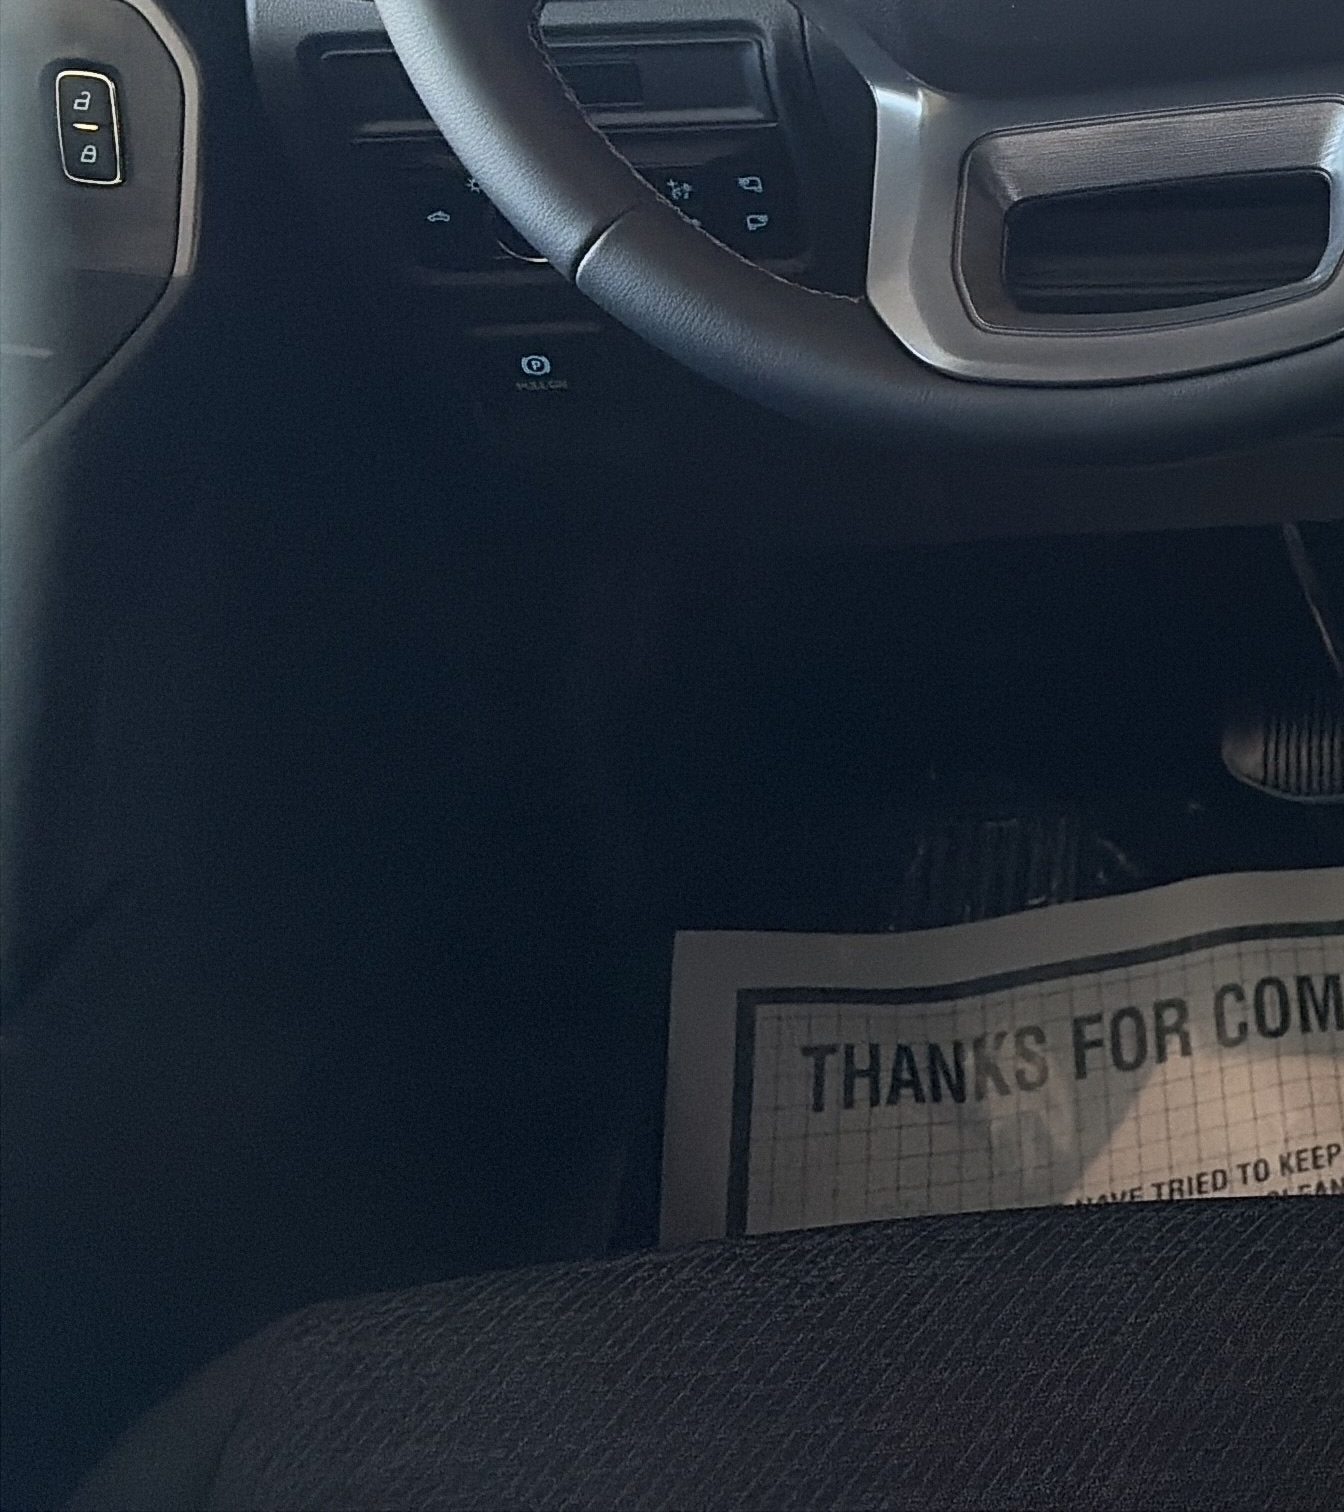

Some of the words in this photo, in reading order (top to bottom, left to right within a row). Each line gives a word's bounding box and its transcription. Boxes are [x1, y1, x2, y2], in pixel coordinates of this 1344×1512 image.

[801, 1024, 1049, 1113] THANKS
[1071, 996, 1192, 1081] FOR
[1075, 1186, 1142, 1205] VE
[1151, 1168, 1228, 1202] TRIED
[1236, 1158, 1270, 1187] TO
[1279, 1143, 1342, 1178] KEEP
